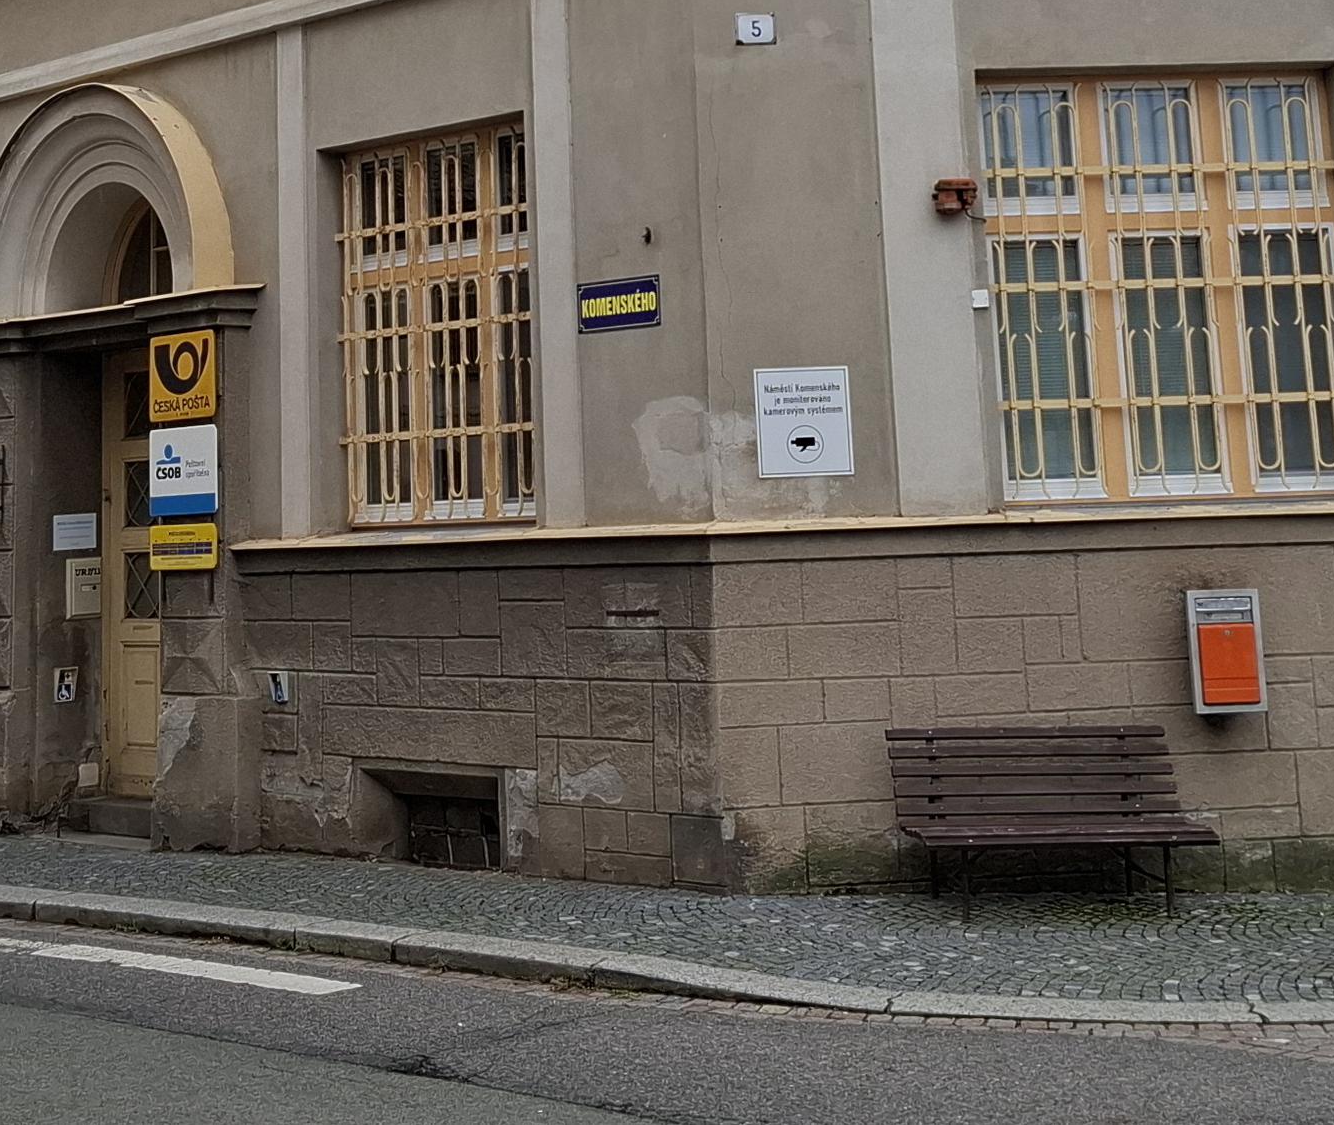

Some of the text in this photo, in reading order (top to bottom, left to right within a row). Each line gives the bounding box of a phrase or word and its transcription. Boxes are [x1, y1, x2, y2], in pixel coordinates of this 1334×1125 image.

[751, 20, 762, 37] 5
[582, 288, 656, 319] KOMENSKÉHO
[795, 382, 840, 393] Komenského
[153, 394, 211, 413] ČESKÁ POŠTA
[783, 394, 831, 404] monitorováno
[763, 406, 805, 417] kamerovým
[155, 466, 181, 480] ČSOB
